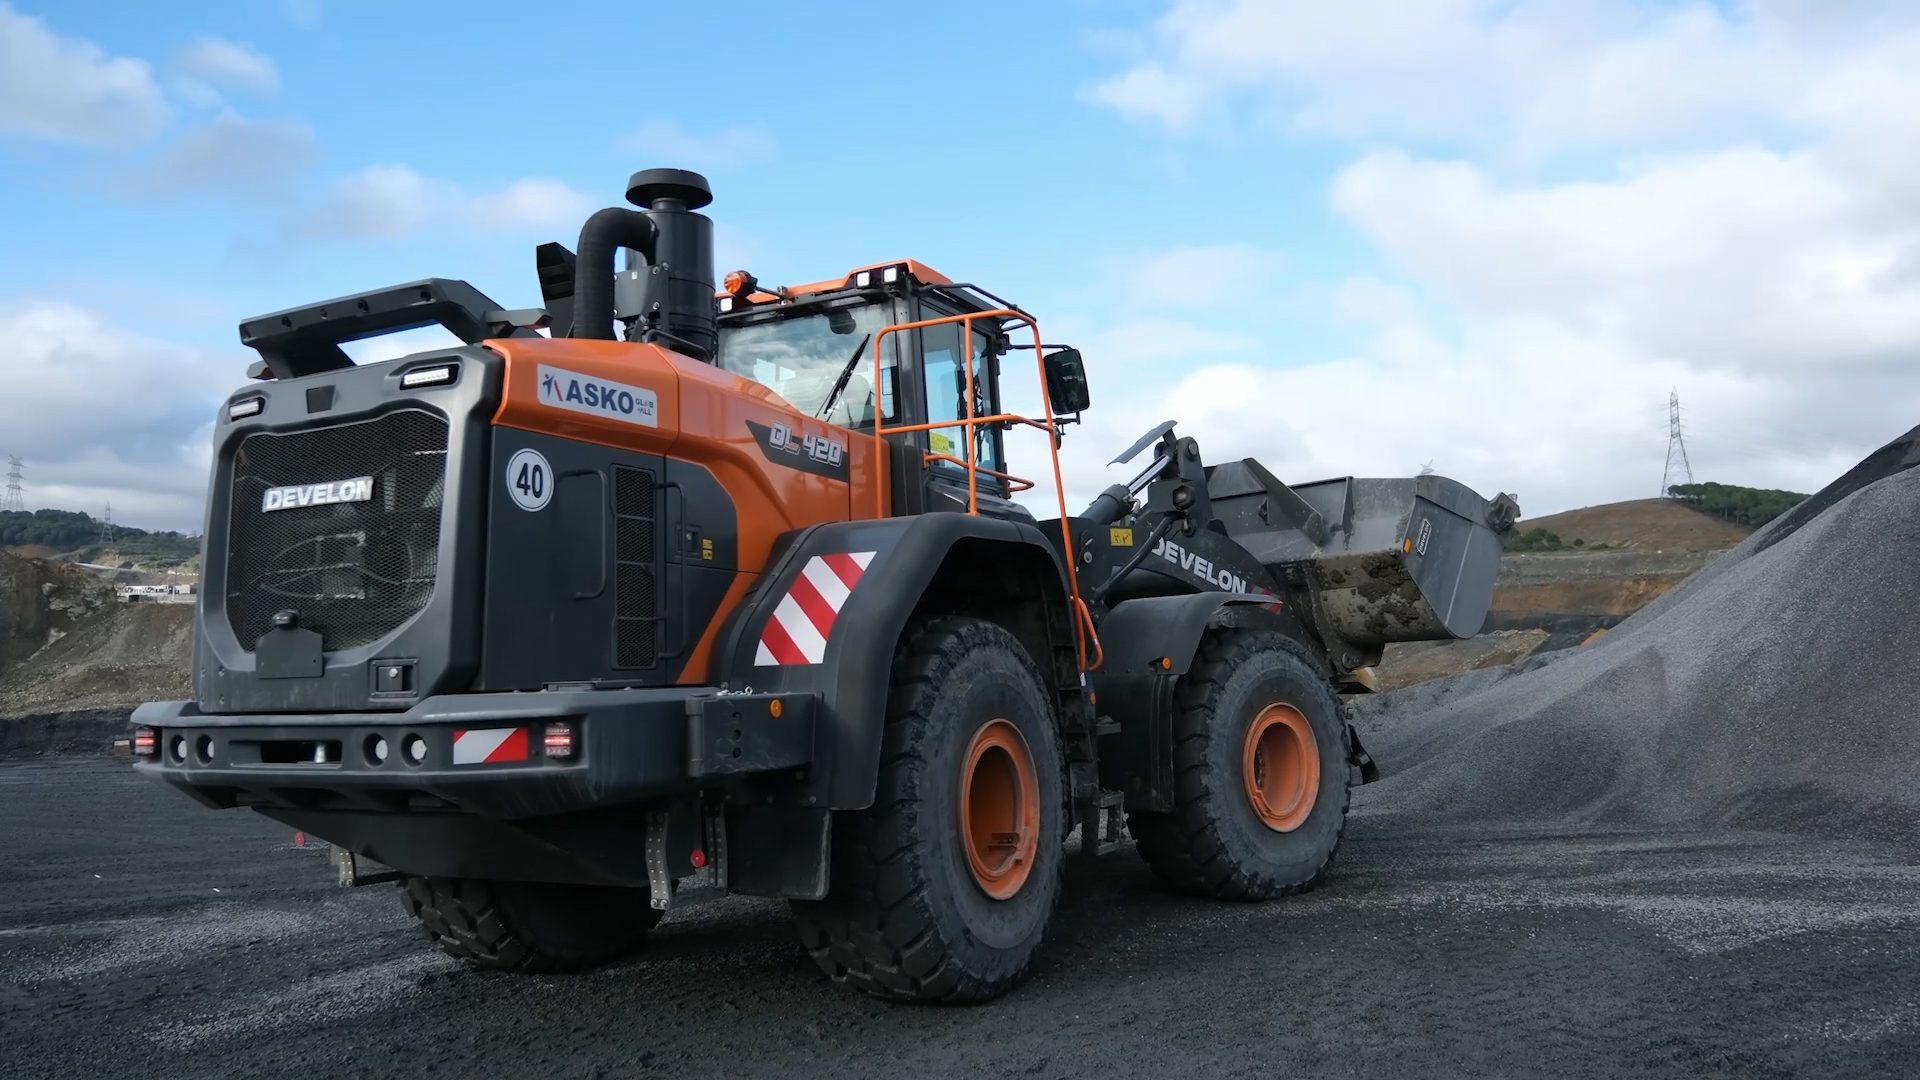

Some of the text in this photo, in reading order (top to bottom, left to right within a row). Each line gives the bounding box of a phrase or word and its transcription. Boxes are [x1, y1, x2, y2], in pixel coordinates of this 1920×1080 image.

[566, 379, 634, 415] ASKO
[769, 422, 842, 467] DL 420
[265, 478, 373, 511] DEVELON
[516, 462, 544, 499] 40
